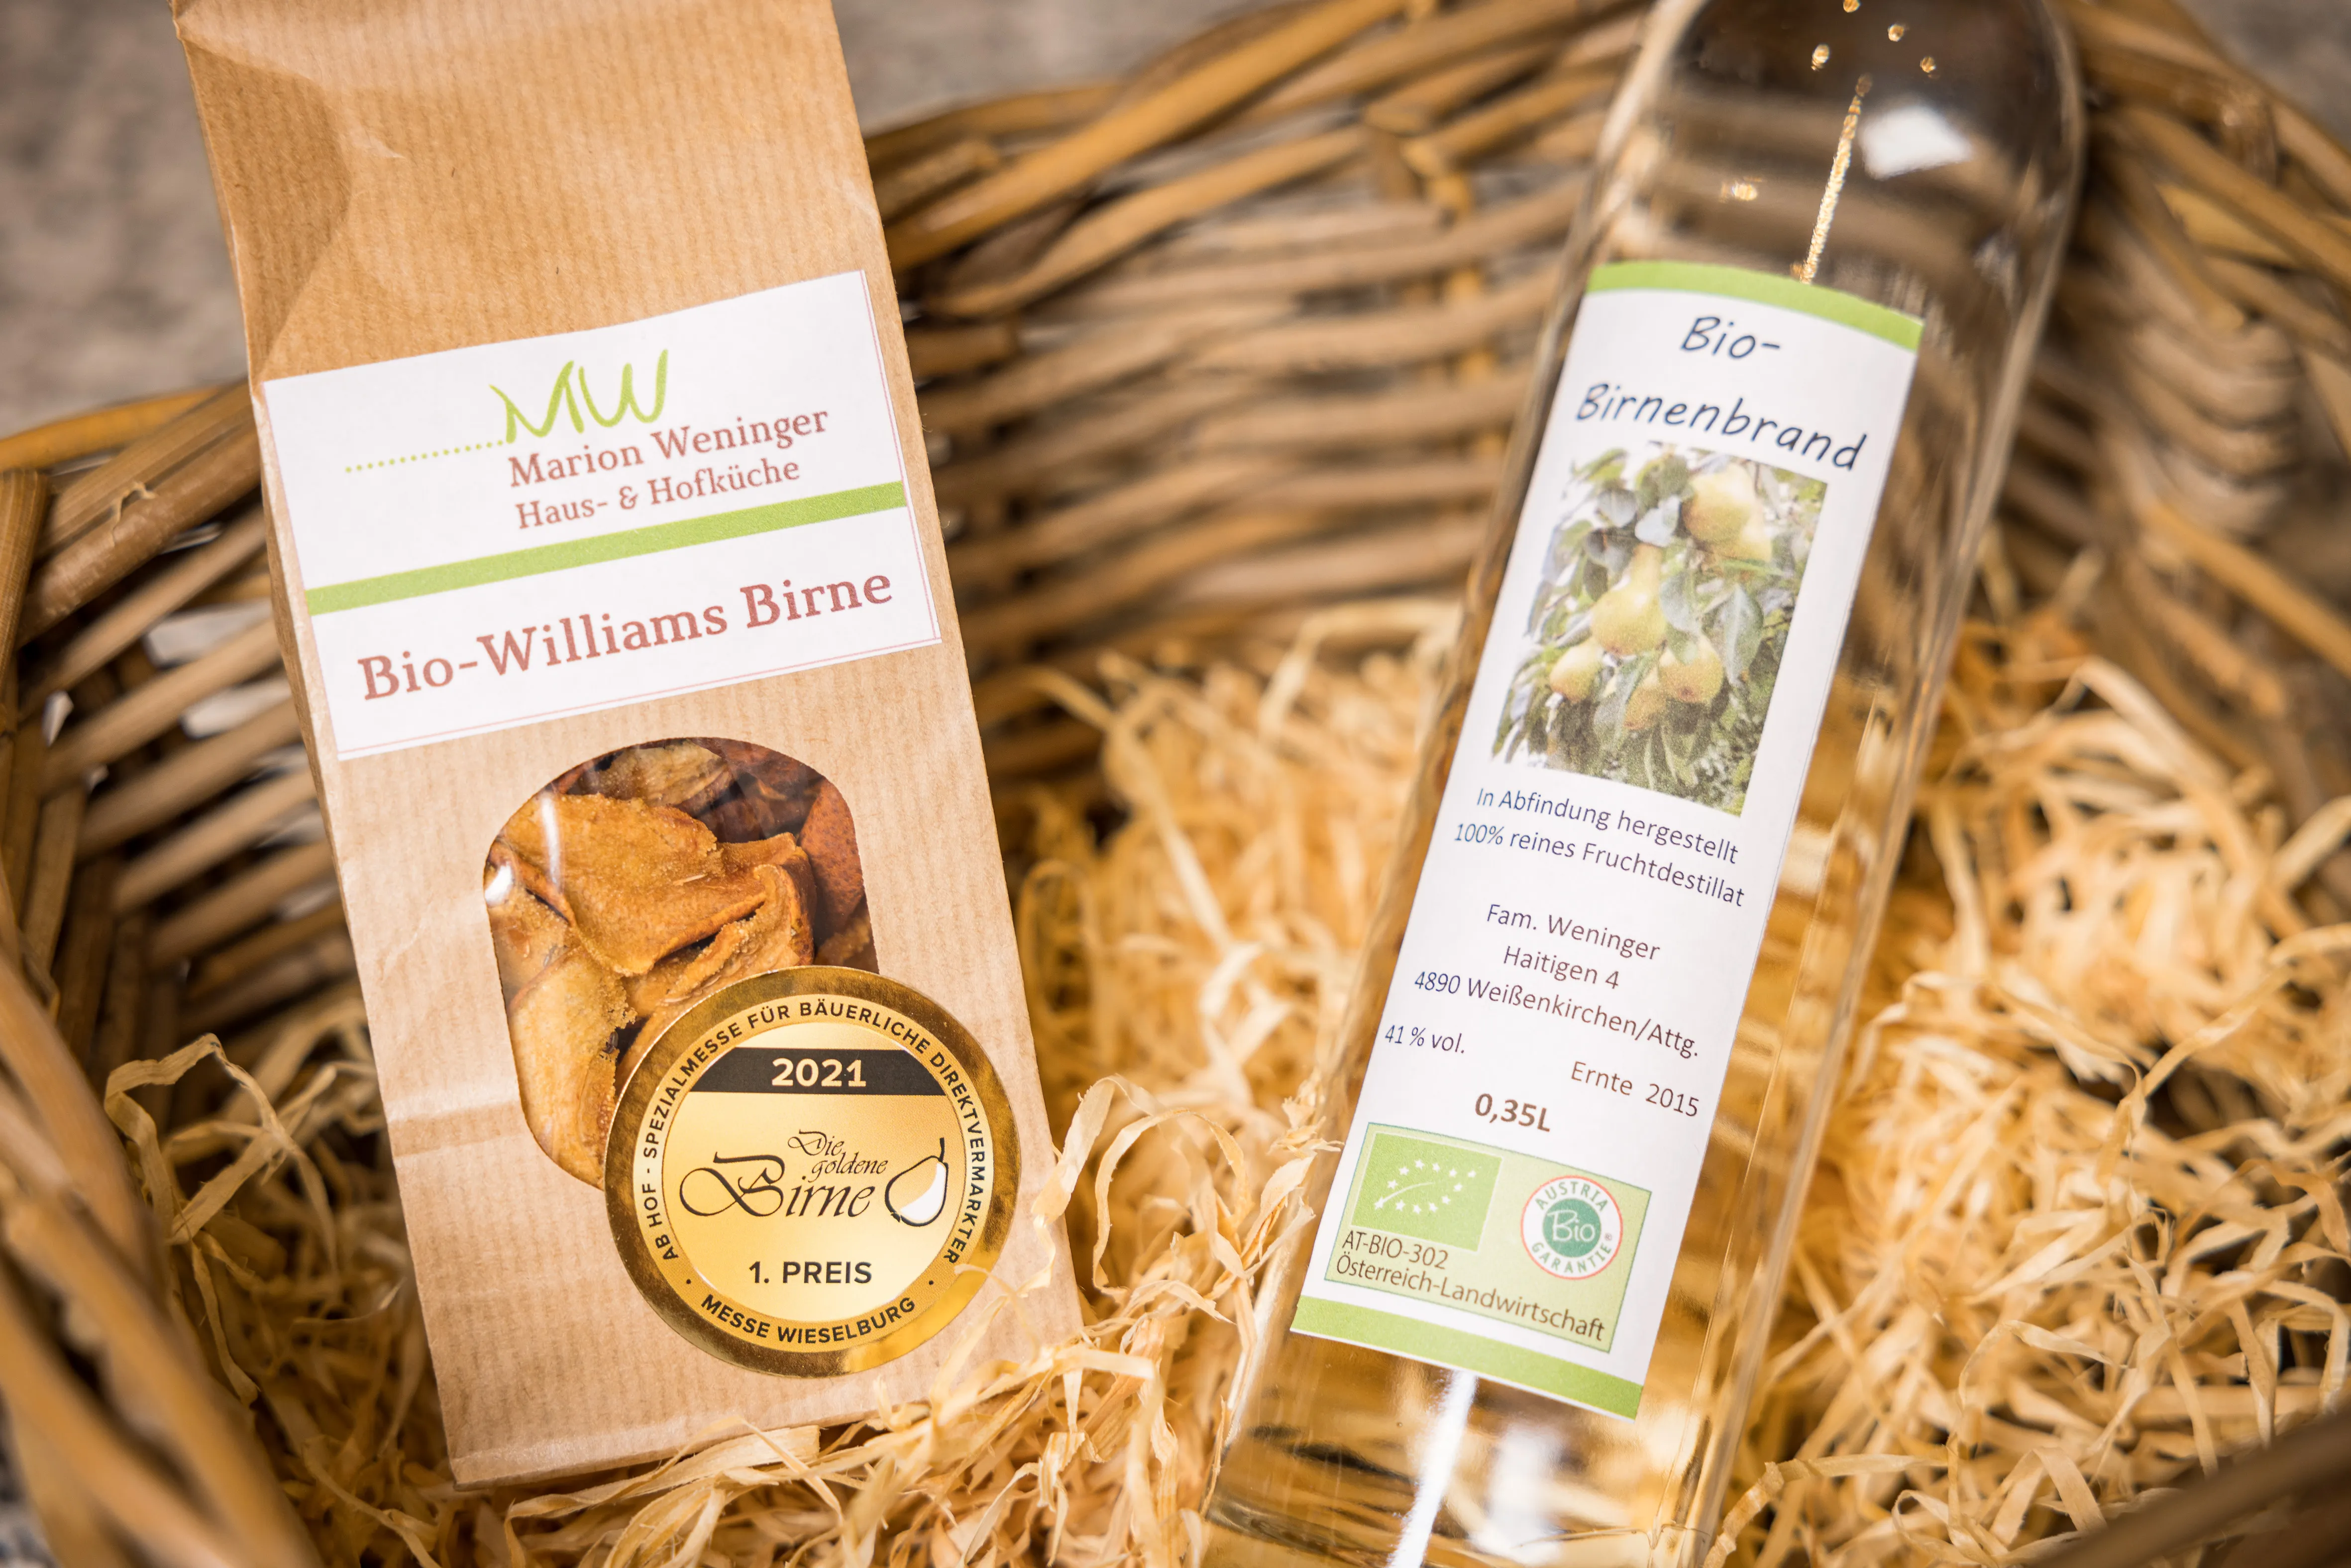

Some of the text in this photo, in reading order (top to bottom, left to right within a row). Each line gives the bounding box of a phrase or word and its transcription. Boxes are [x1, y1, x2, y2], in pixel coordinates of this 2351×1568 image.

[1679, 316, 1781, 359] Bio-
[507, 410, 830, 488] Marion Weninger
[1576, 382, 1867, 471] Birnenbrand
[515, 457, 801, 529] Haus- & Hofküche
[357, 574, 893, 702] Bio-Williams Birne
[1476, 788, 1739, 864] In Abfindung hergestellt
[1454, 824, 1745, 907] 100% reines Fruchtdestillat
[1487, 904, 1661, 960] Fam. Weninger
[1503, 946, 1620, 990] Haitigen 4
[747, 1004, 791, 1028] FÜR
[800, 999, 932, 1054] BÄUERLICHE
[1414, 971, 1699, 1059] 4890 Weißenkirchen/Attg.
[1385, 1025, 1465, 1055] 41 % vol.
[643, 1022, 743, 1159] SPEZIALMESSE
[771, 1058, 866, 1088] 2021
[1571, 1061, 1699, 1117] Ernte 2015
[1474, 1093, 1552, 1133] 0,35L
[788, 1129, 842, 1156] Die
[930, 1051, 986, 1264] DIREKTVERMARKTER
[679, 1151, 875, 1218] Birne
[810, 1151, 888, 1183] goldene
[642, 1183, 663, 1228] HOF
[1535, 1181, 1608, 1212] AUSTRIA
[655, 1235, 678, 1259] AB
[1342, 1230, 1449, 1270] AT-BIO-302
[1548, 1210, 1595, 1242] Bio
[749, 1261, 873, 1284] 1. PREIS
[1531, 1242, 1613, 1274] GARANTIE
[700, 1294, 916, 1345] MESSE WIESELBURG
[1336, 1254, 1605, 1342] Österreich-Landwirtschaft
